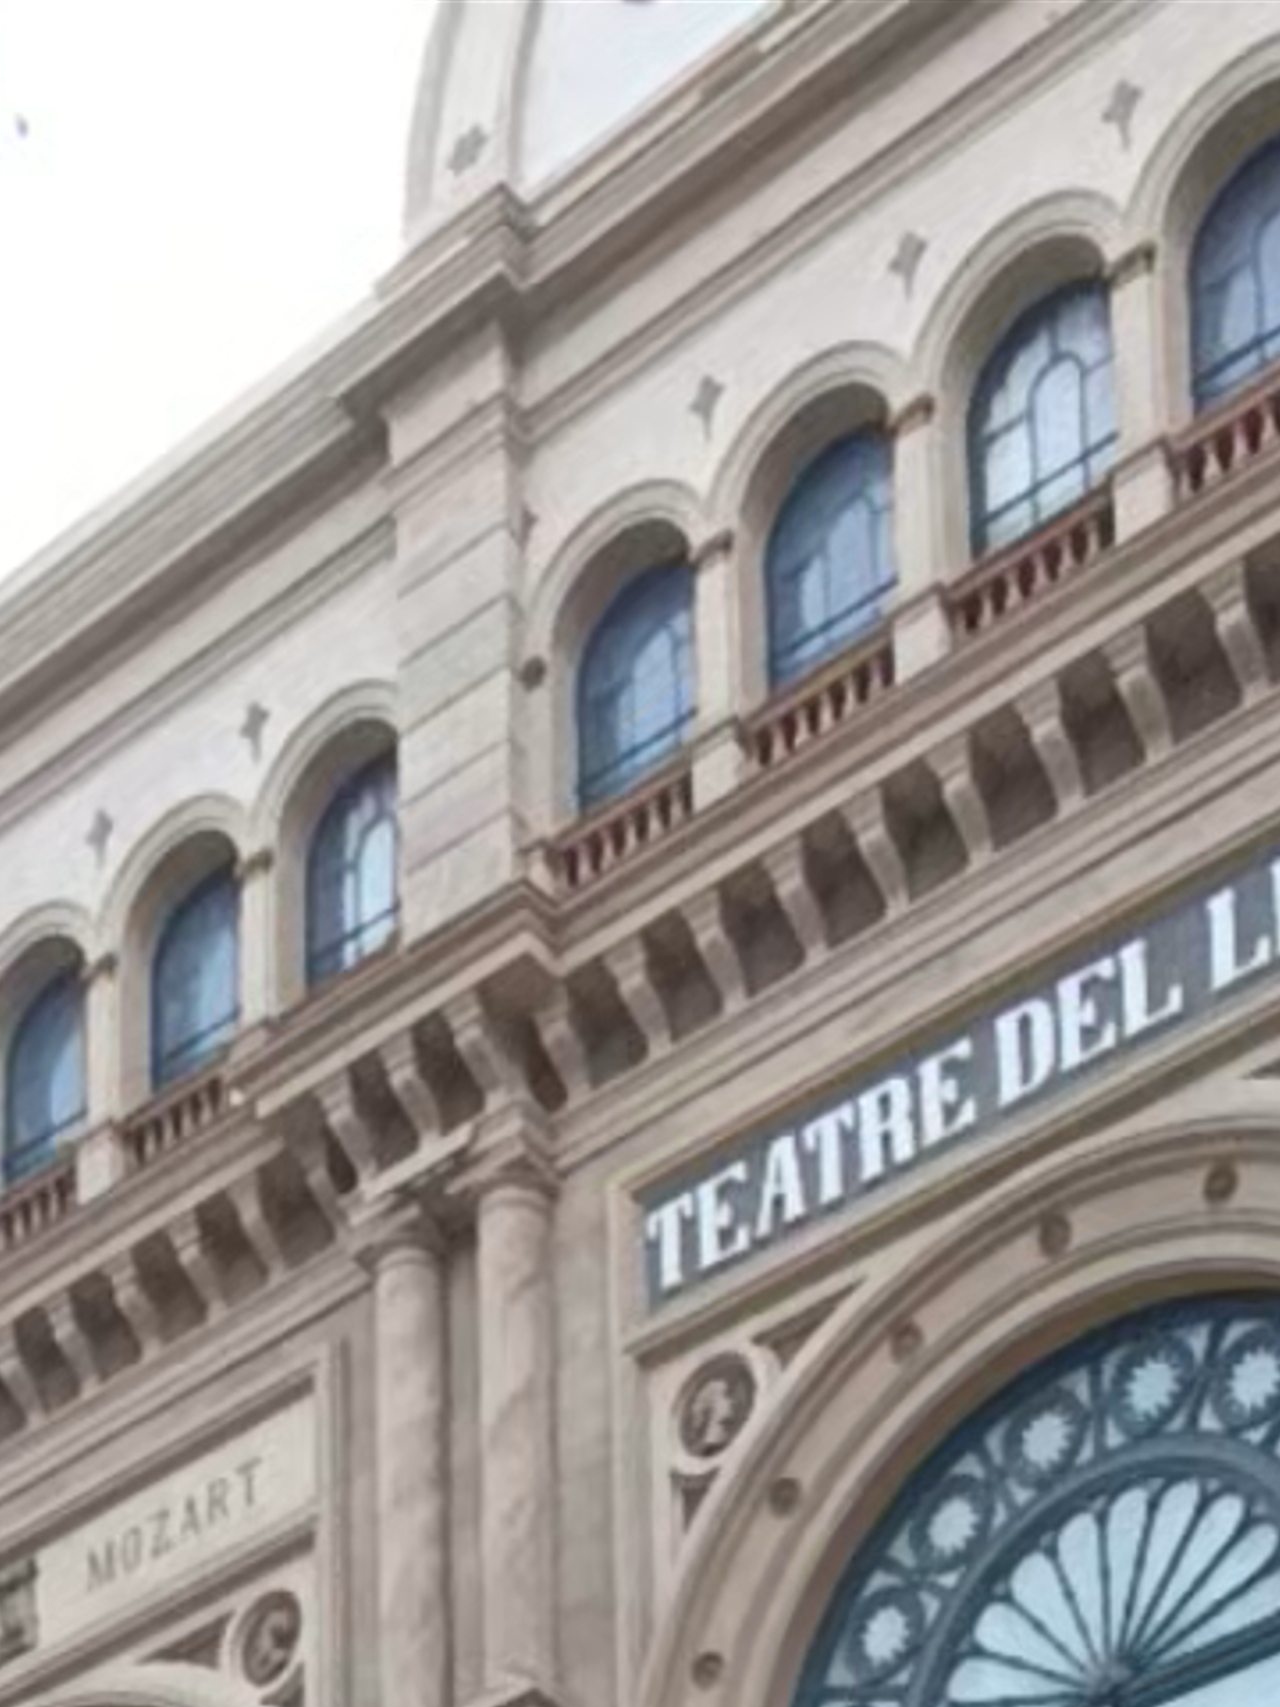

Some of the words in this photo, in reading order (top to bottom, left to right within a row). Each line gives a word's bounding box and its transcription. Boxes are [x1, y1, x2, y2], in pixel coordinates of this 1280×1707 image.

[644, 1038, 978, 1293] TEATRE
[996, 940, 1182, 1108] DEL
[86, 1457, 264, 1592] MOZART
